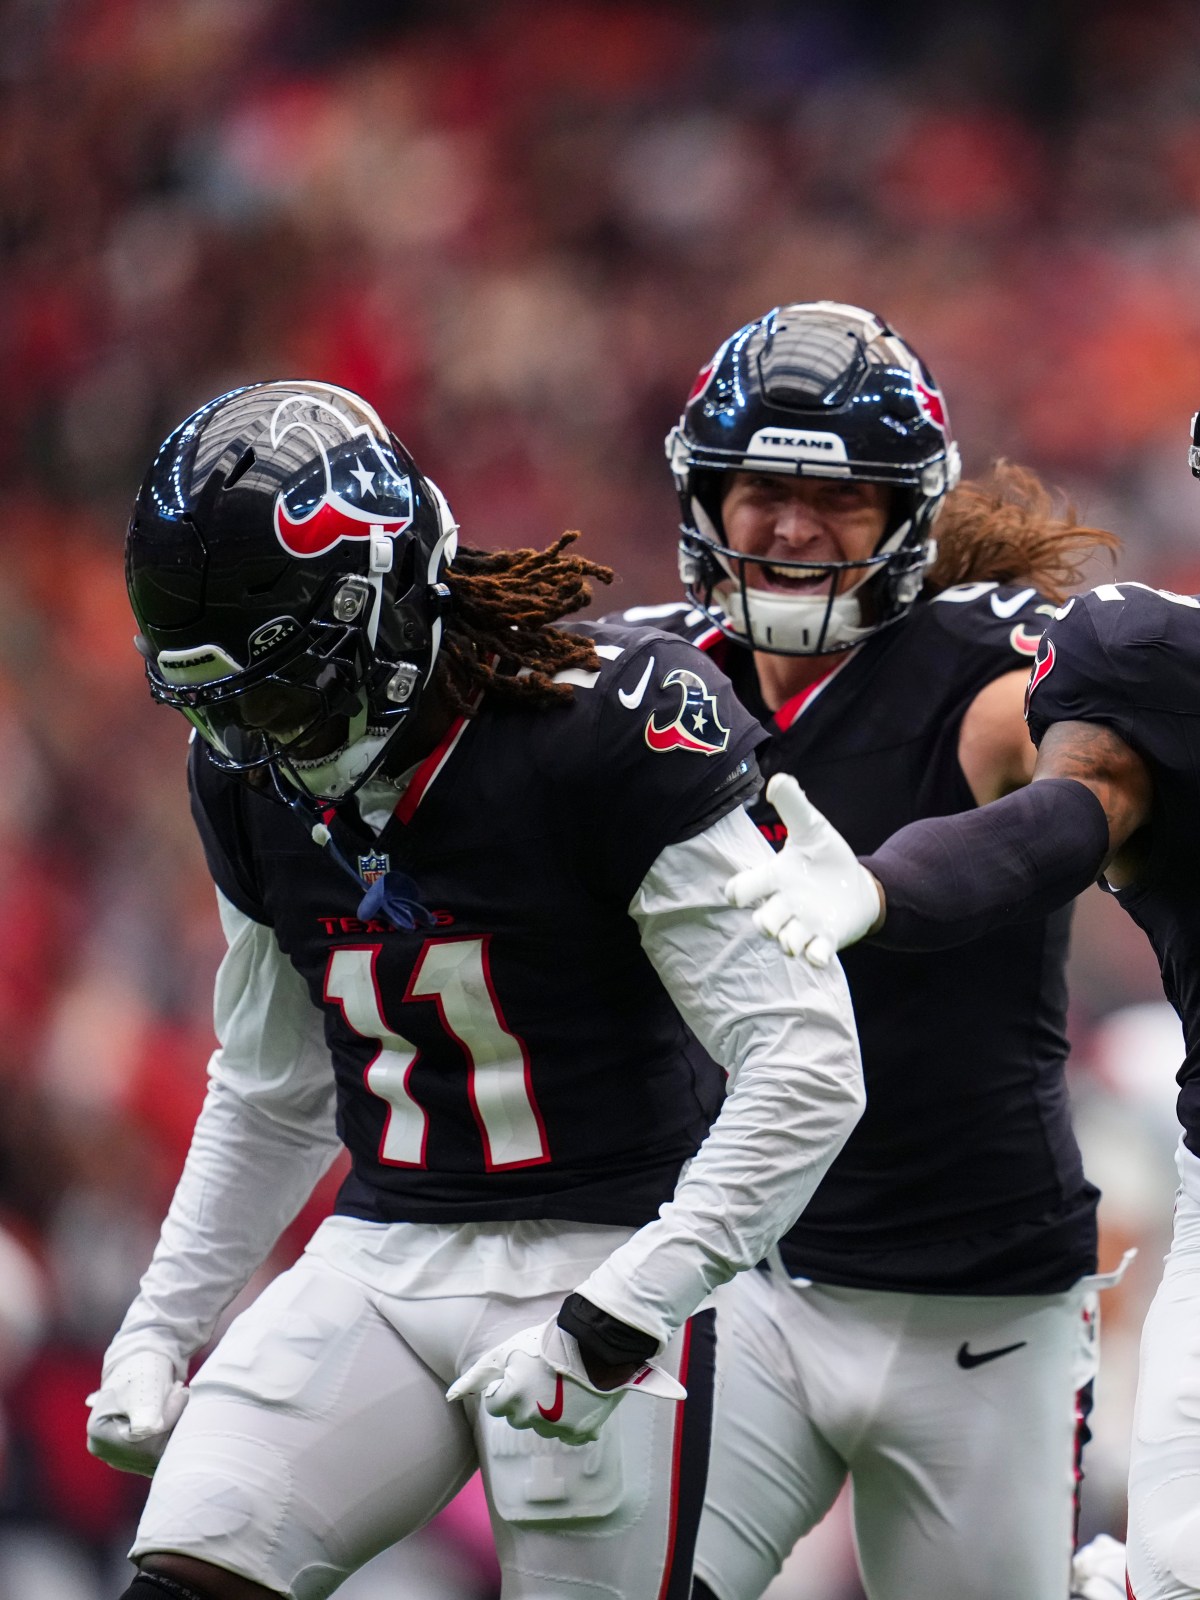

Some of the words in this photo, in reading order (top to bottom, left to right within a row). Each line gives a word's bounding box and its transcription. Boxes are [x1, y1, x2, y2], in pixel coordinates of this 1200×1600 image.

[759, 436, 833, 450] TEXANS
[252, 625, 294, 656] OAKLEY
[316, 909, 455, 935] TEXS
[323, 933, 552, 1173] 11
